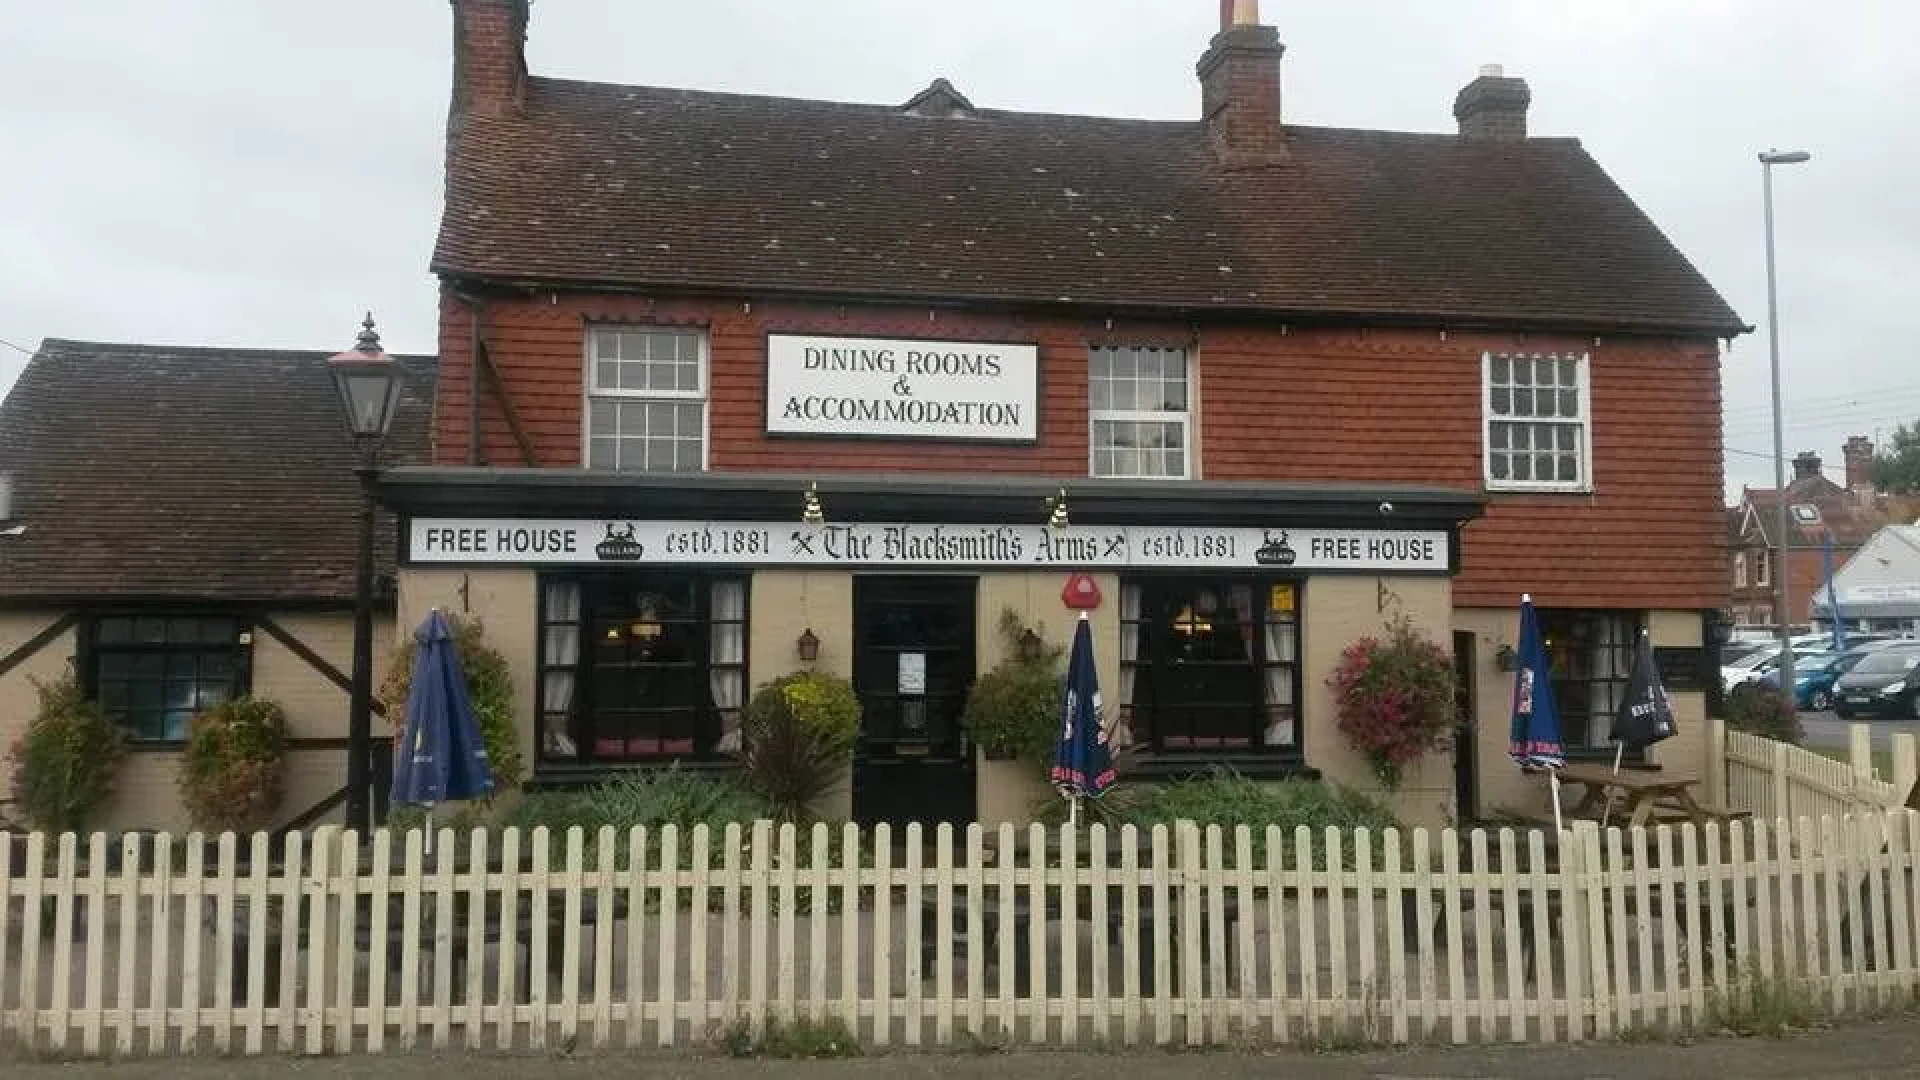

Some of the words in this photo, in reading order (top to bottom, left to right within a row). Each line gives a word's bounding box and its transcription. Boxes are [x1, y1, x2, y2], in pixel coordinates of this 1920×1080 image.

[804, 347, 895, 373] DINING
[906, 351, 1001, 376] ROOMS
[892, 373, 912, 396] &
[783, 395, 1020, 425] ACCOMMODATION
[426, 529, 488, 552] FREE
[497, 529, 577, 552] HOUSE
[824, 525, 872, 559] The
[882, 525, 1022, 561] Blacksmith's
[1034, 527, 1097, 561] Arms
[1311, 537, 1360, 559] FREE
[1368, 538, 1434, 561] HOUSE
